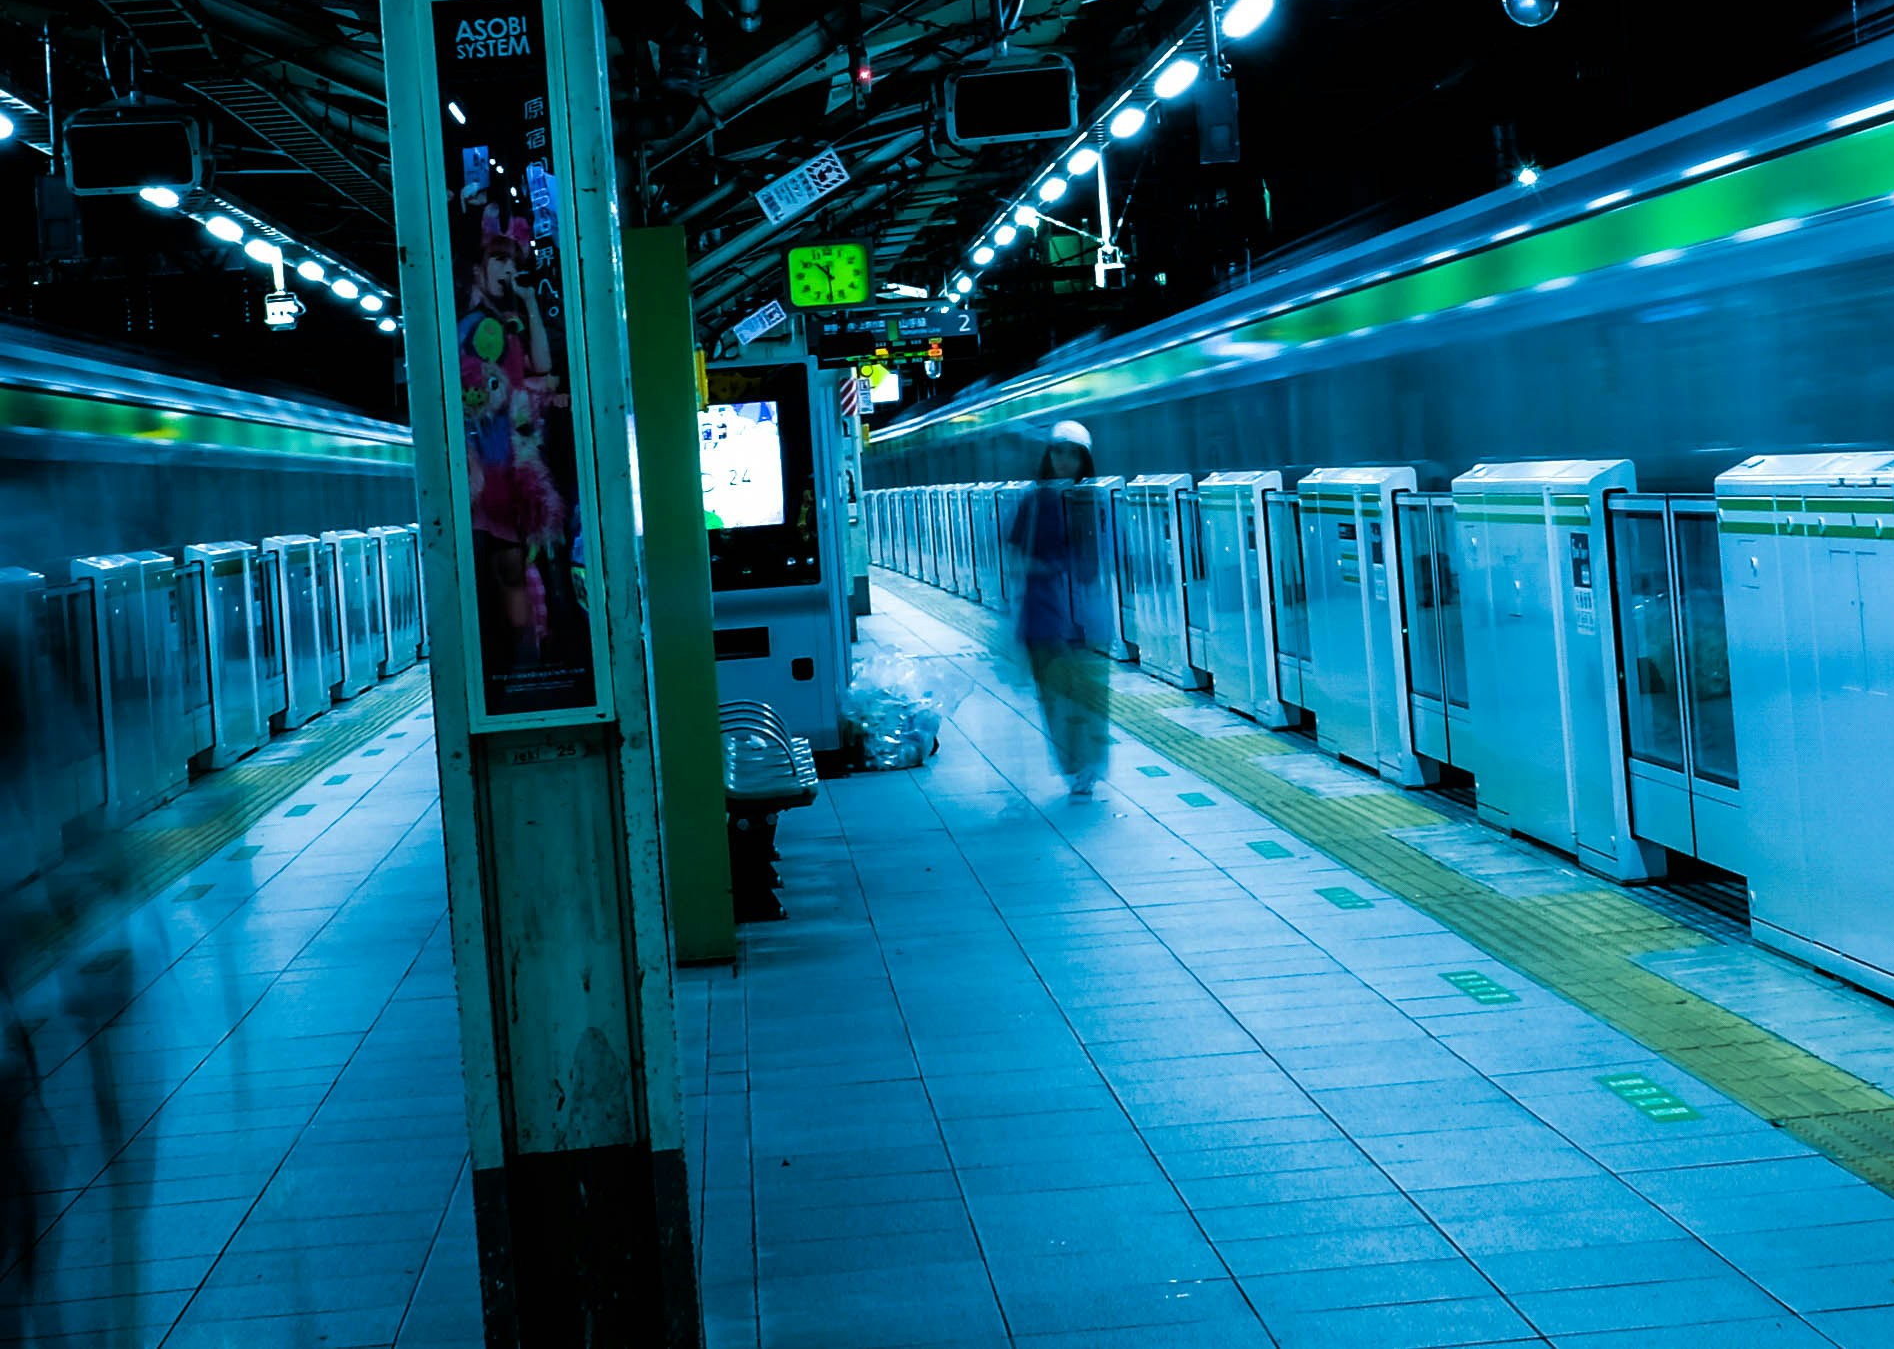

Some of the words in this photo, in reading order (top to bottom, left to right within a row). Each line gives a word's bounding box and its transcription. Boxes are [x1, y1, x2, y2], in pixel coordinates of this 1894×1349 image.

[455, 16, 527, 43] ASOBI
[457, 36, 531, 60] SYSTEM
[958, 314, 971, 332] 2
